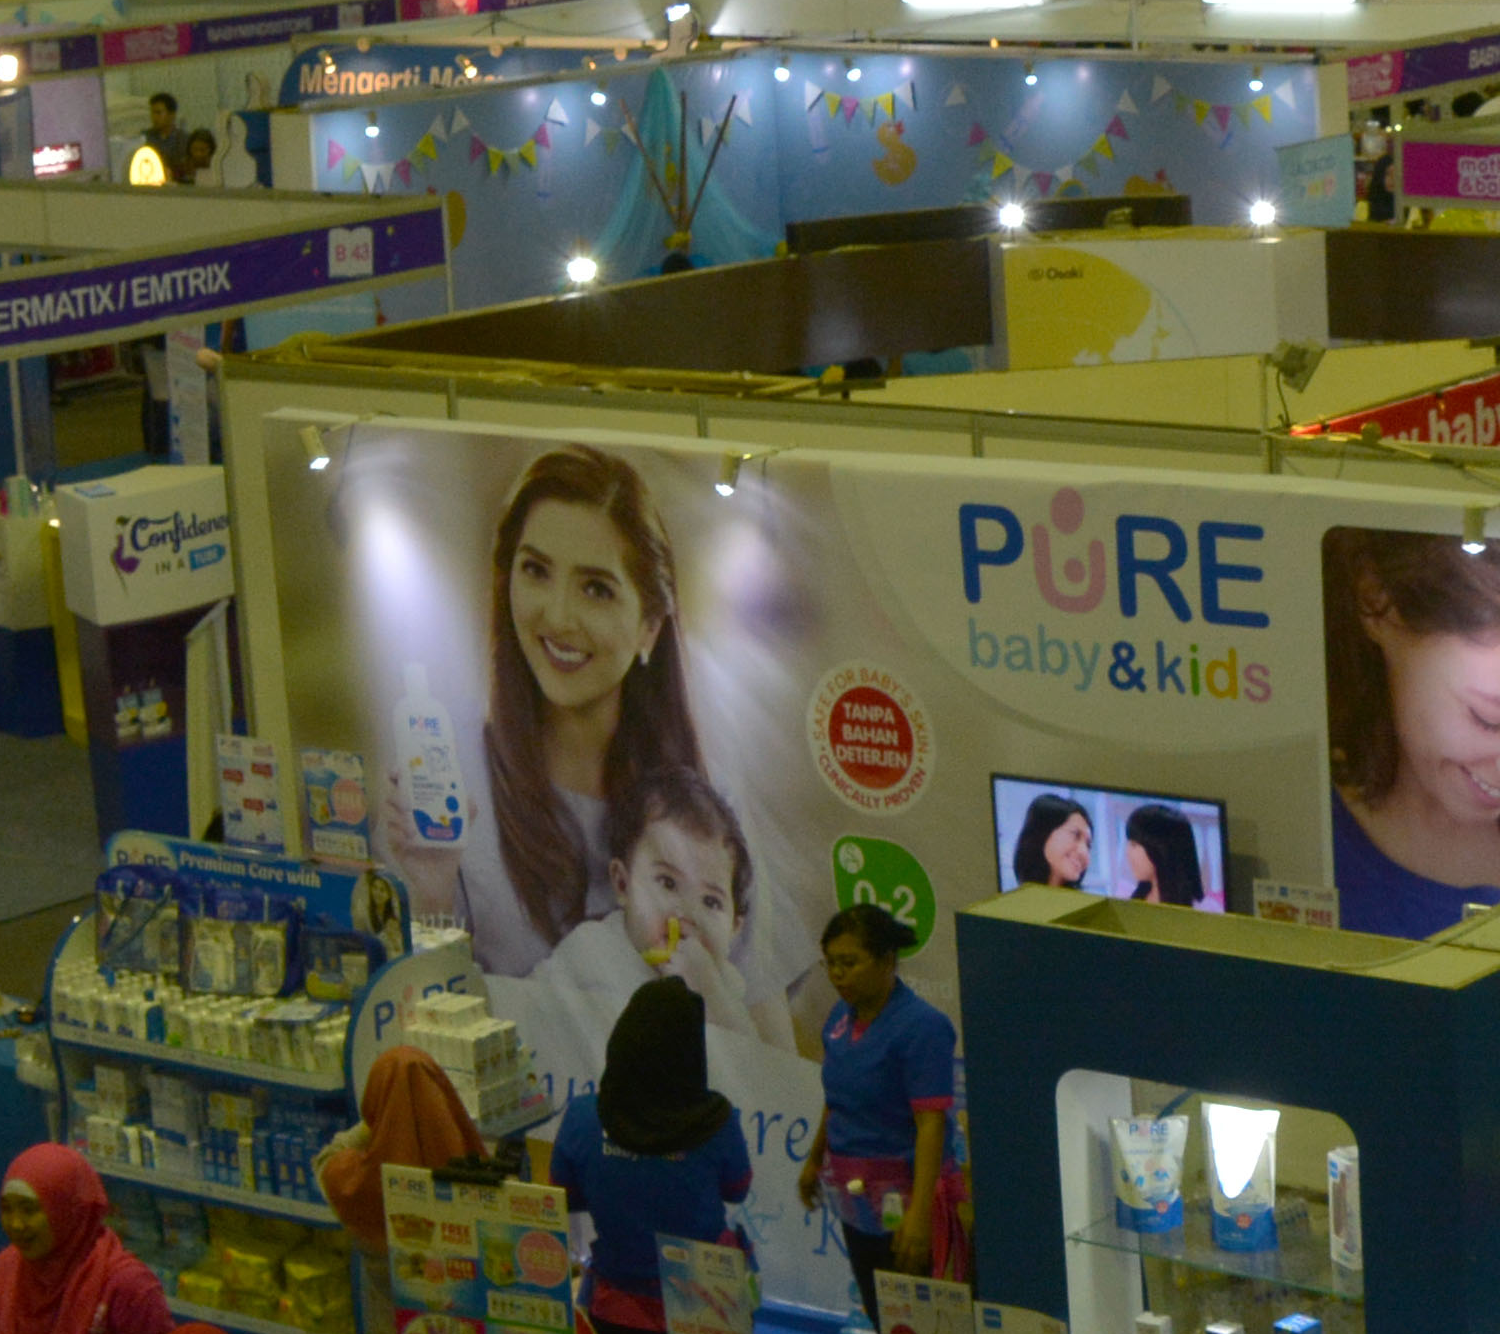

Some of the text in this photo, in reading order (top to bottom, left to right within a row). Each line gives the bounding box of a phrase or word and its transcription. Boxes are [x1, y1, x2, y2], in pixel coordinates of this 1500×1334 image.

[131, 261, 232, 310] EMTRIX
[959, 489, 1269, 629] PURE
[813, 688, 833, 741] SAFE
[826, 668, 855, 695] FOR
[842, 702, 895, 723] TANPA
[841, 723, 898, 745] BAHAN
[835, 745, 908, 768] DETERJEN
[818, 754, 926, 810] CLINICALLY PROVEN
[180, 849, 246, 877] Premium
[249, 859, 285, 880] Care
[287, 866, 321, 889] with
